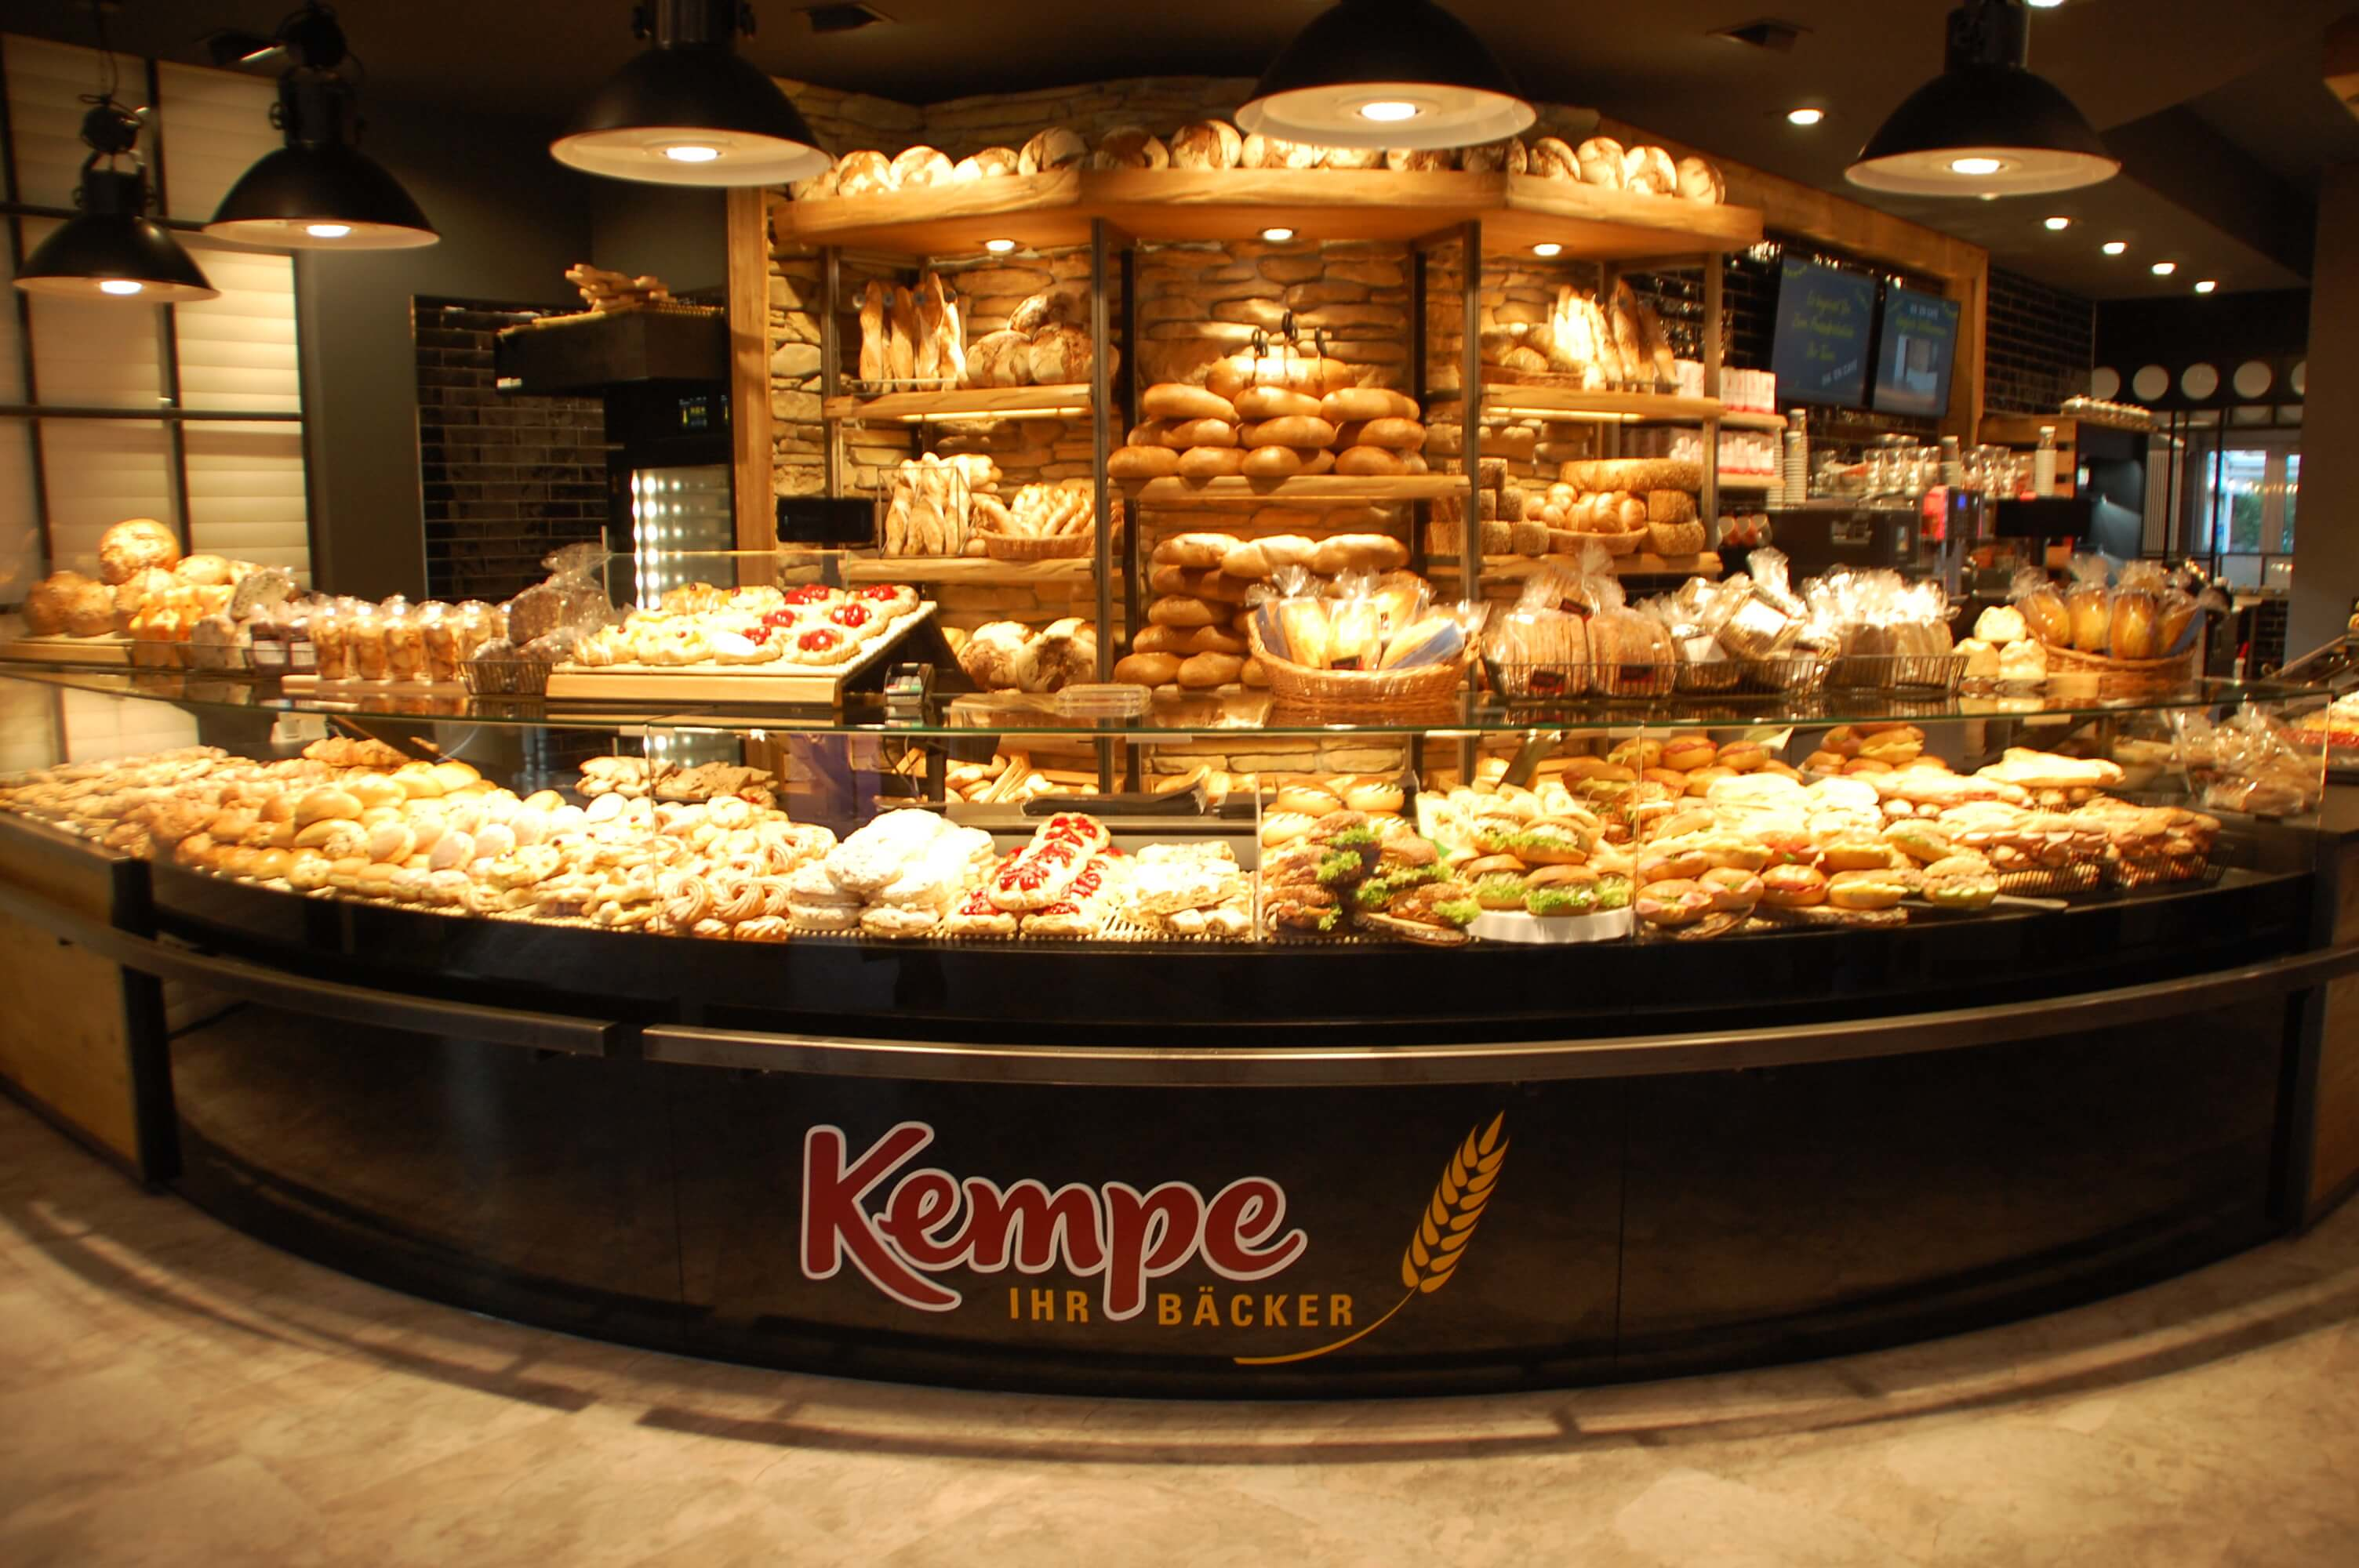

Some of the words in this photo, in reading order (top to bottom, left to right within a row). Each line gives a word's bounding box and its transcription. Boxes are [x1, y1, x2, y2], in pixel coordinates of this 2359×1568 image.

[801, 1121, 1308, 1321] Kempe
[1009, 1287, 1089, 1323] IHR
[1157, 1286, 1354, 1327] BÄCKER
